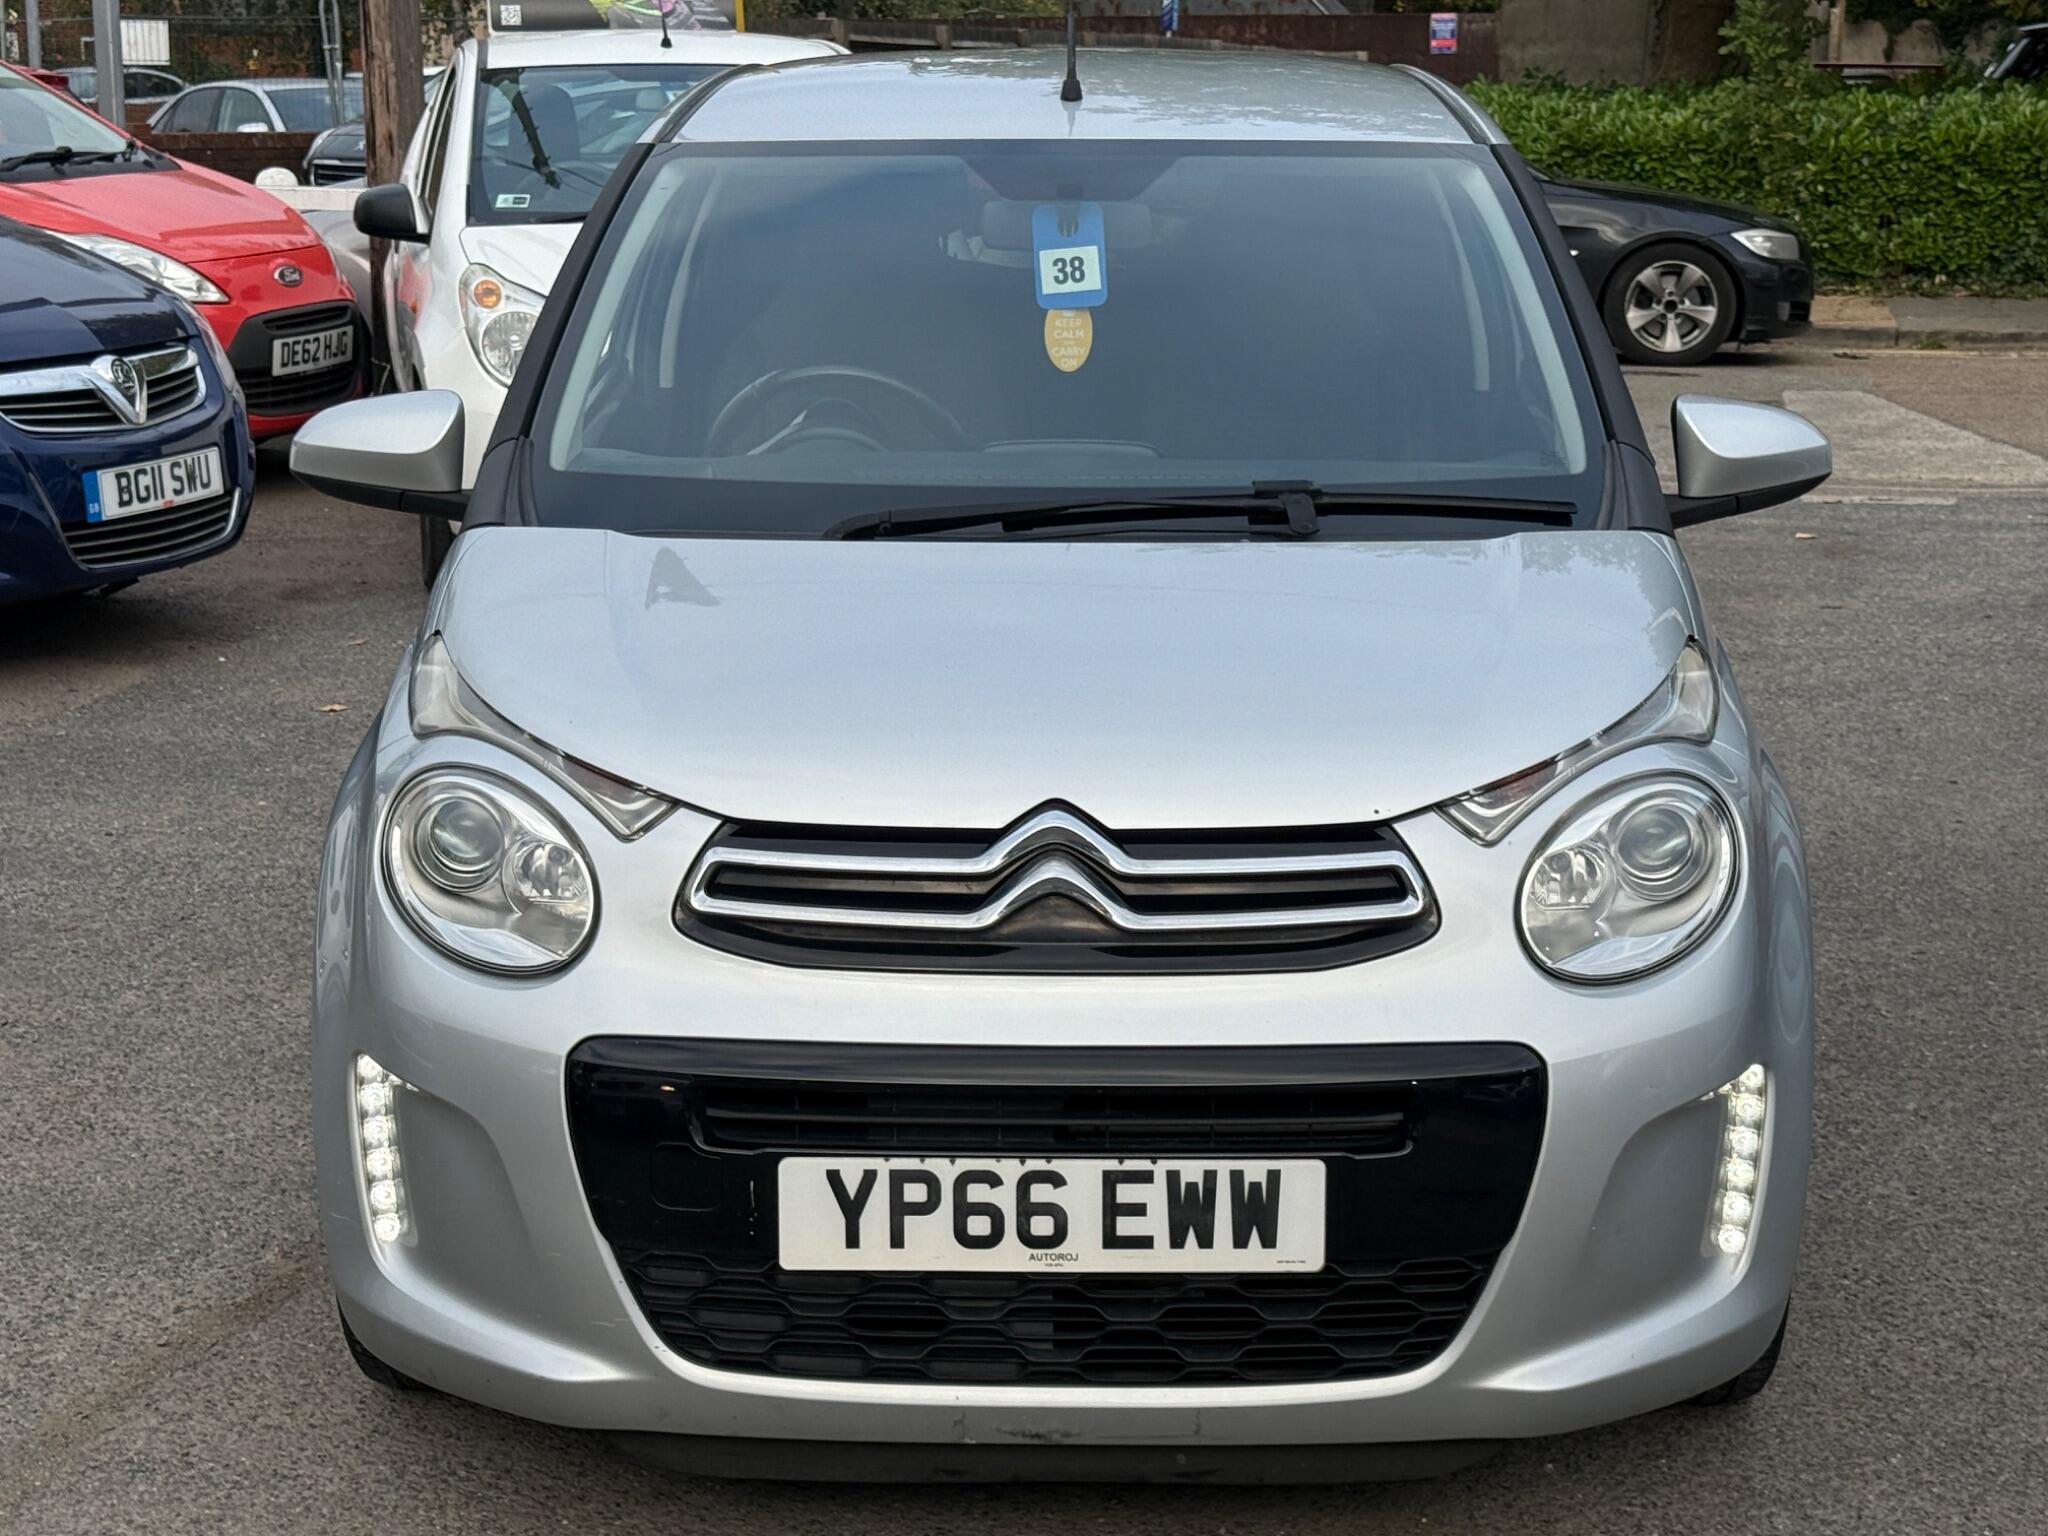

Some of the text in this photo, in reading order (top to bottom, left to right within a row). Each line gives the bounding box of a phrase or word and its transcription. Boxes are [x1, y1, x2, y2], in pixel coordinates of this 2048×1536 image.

[1052, 256, 1086, 285] 38
[1055, 318, 1082, 328] KEEP
[1053, 329, 1085, 339] CALM
[281, 330, 348, 369] DE62 HJG
[1051, 346, 1086, 357] CARRY
[115, 453, 212, 508] BG11 SWU
[88, 502, 100, 514] GB
[825, 1168, 1282, 1250] YP66 EWW
[1028, 1252, 1079, 1262] AUTOROJ
